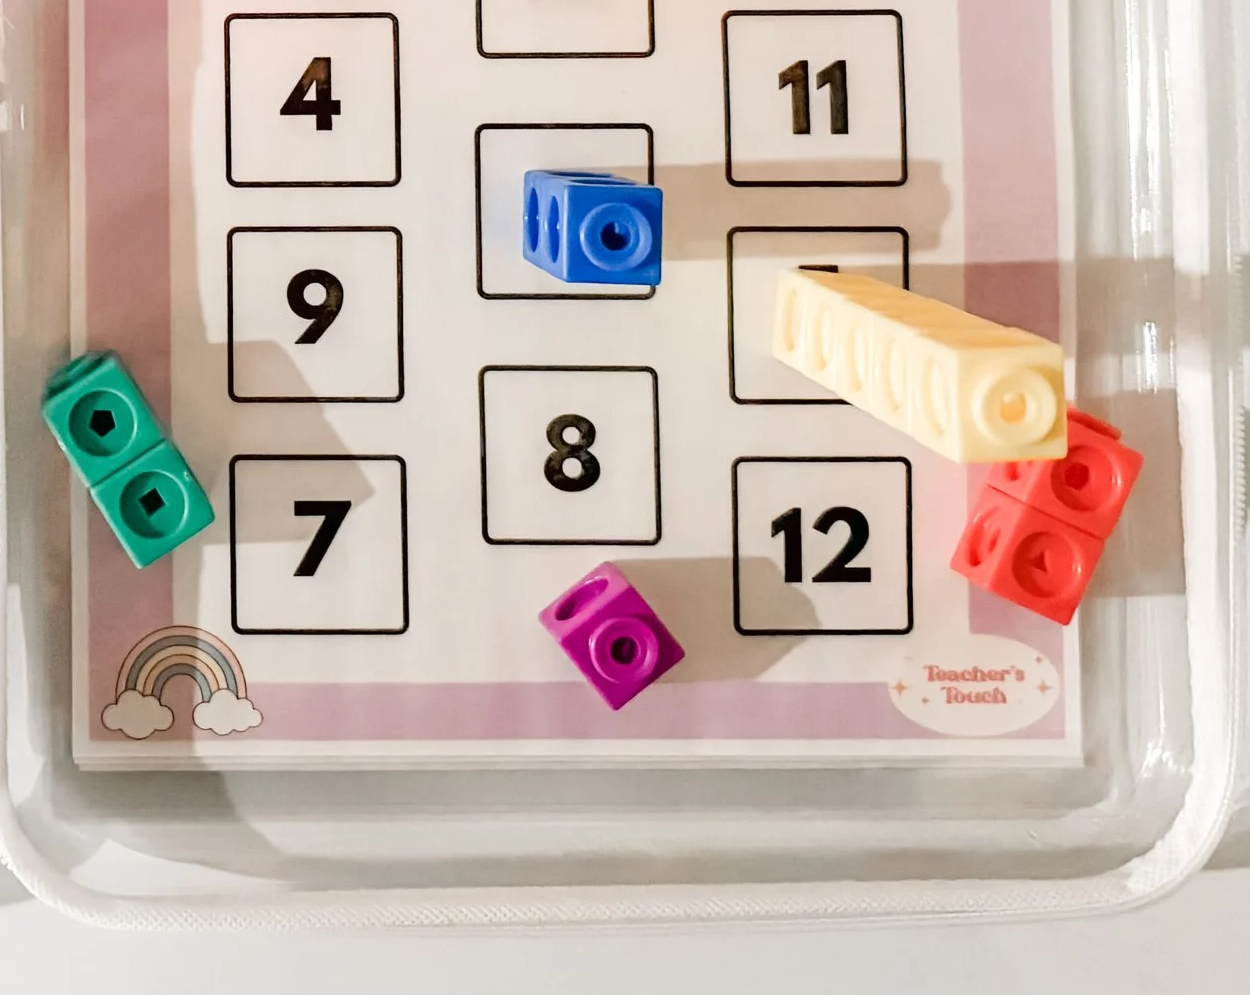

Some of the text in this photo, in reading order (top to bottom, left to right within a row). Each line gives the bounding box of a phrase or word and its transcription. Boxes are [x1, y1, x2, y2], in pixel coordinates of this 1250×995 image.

[279, 56, 342, 131] 4
[778, 59, 850, 135] 11
[286, 268, 344, 345] 9
[543, 414, 601, 493] 8
[293, 500, 352, 577] 7
[770, 506, 872, 584] 12
[924, 665, 1025, 682] Teacher's
[940, 686, 1007, 704] Touch
